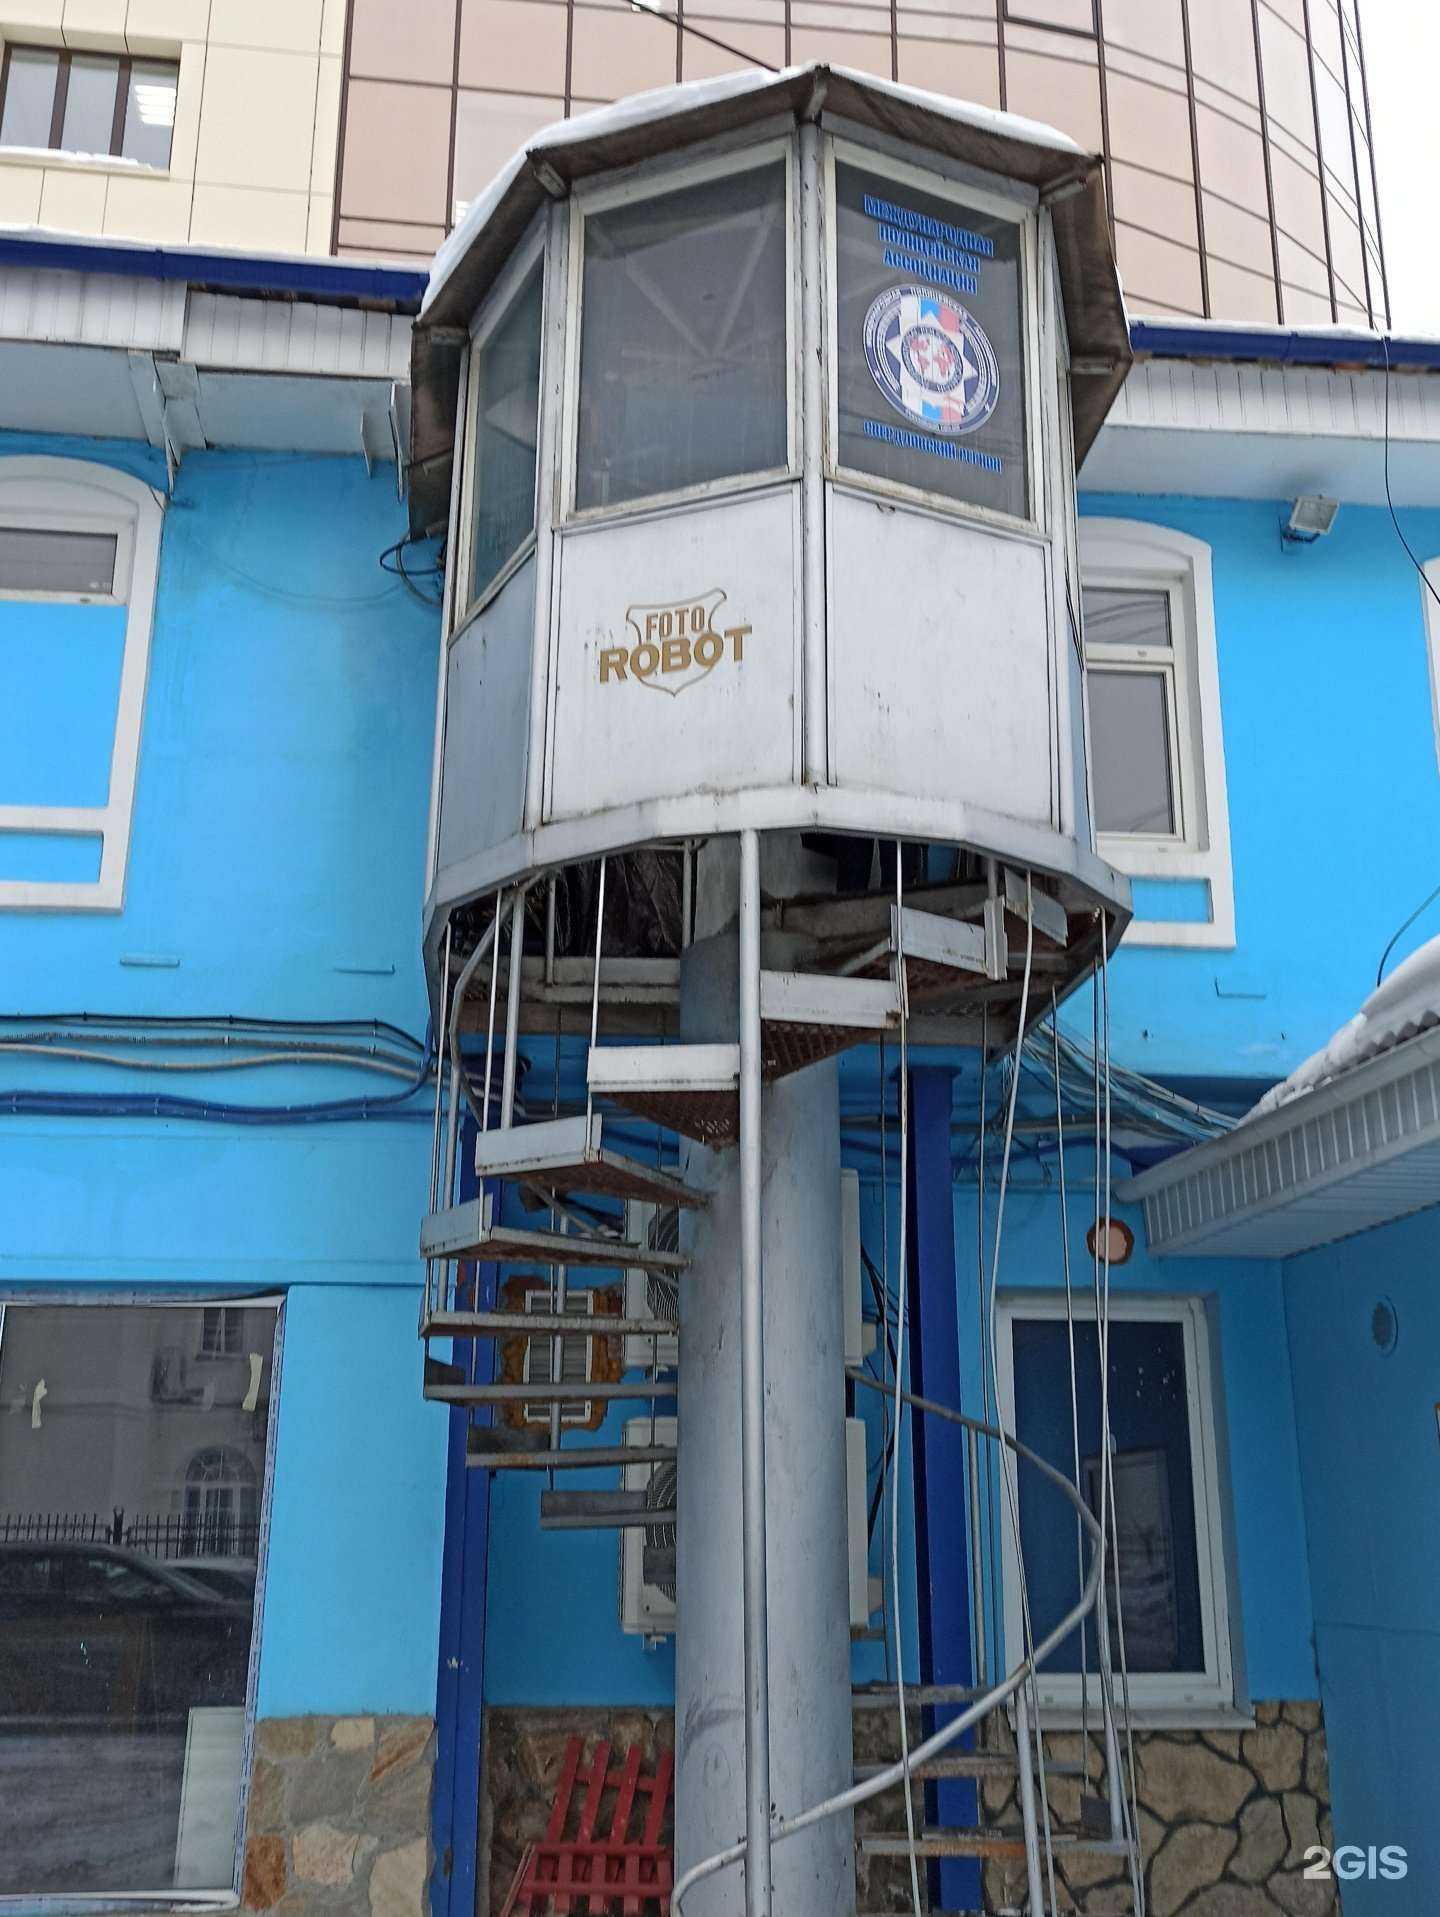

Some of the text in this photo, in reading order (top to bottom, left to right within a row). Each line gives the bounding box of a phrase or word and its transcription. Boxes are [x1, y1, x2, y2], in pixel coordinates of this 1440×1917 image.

[878, 222, 981, 273] ПОЛИЦЕЙСКАЯ
[645, 605, 706, 641] FOTO
[599, 624, 752, 684] ROBOT
